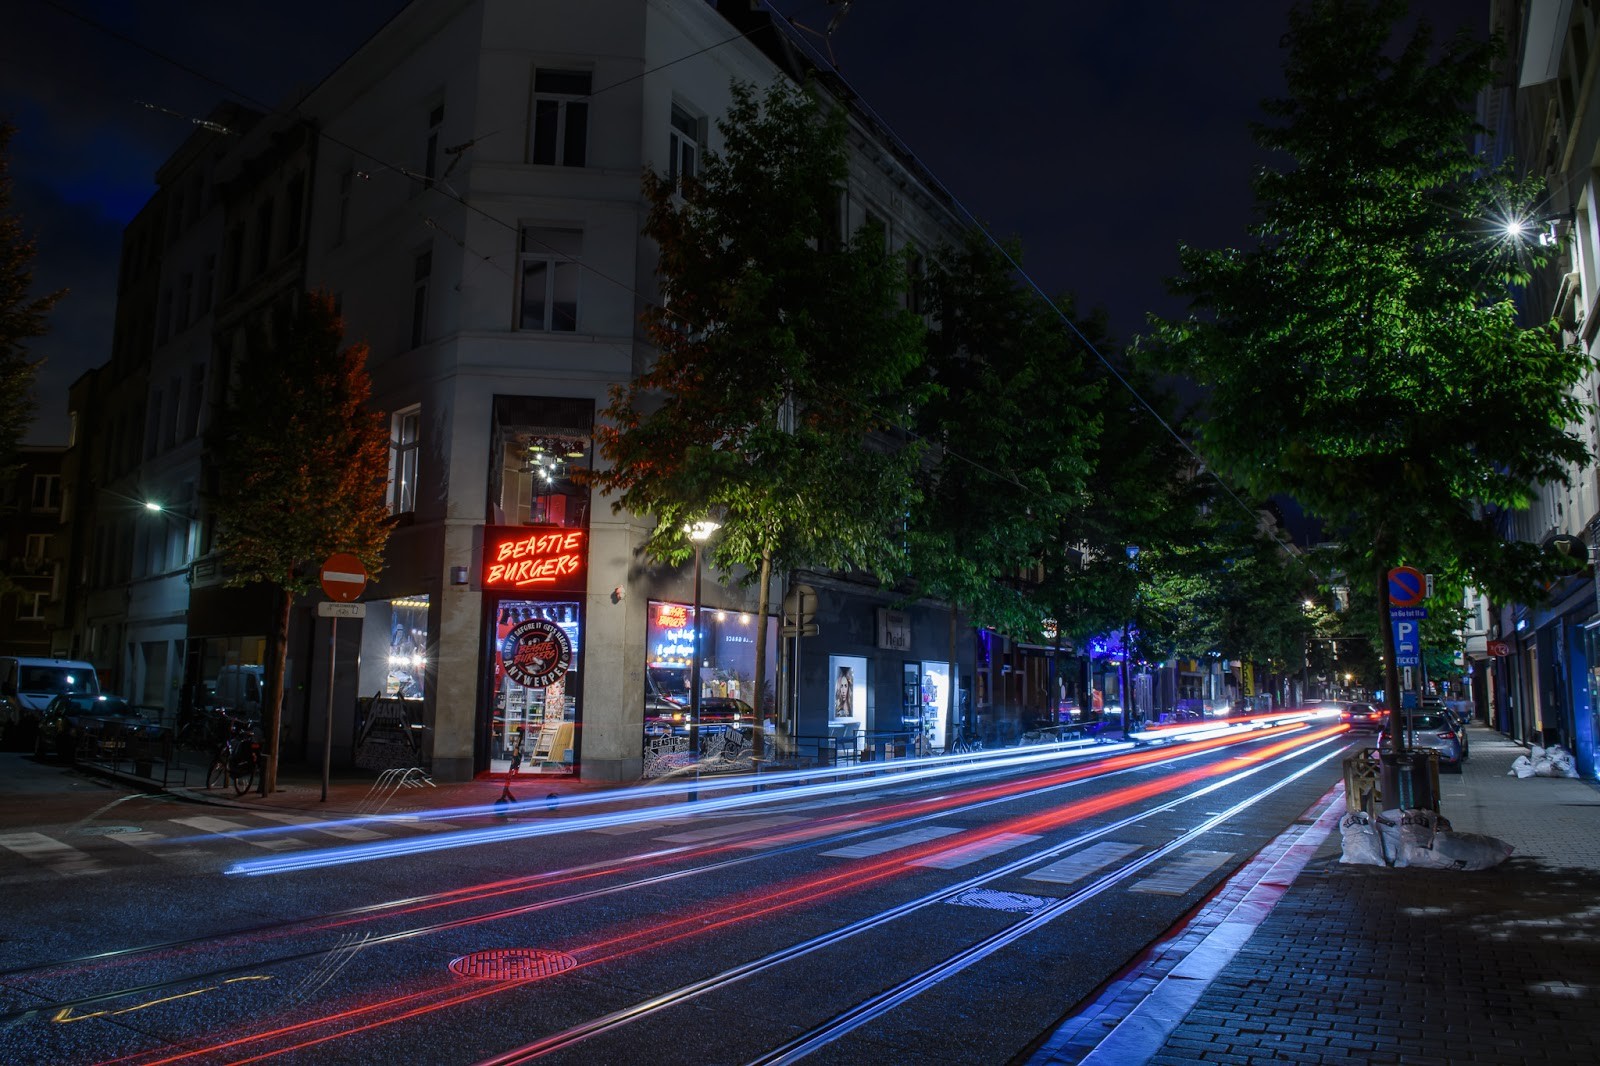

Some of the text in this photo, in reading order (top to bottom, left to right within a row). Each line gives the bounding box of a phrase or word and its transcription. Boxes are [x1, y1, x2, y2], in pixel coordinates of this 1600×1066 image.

[497, 531, 582, 561] BEASTIE
[487, 554, 580, 584] BURGERS
[503, 640, 513, 653] TRY
[514, 622, 536, 637] BEFORE
[543, 623, 558, 635] GETS
[555, 631, 569, 654] ILLEGAL
[1398, 622, 1412, 641] P
[513, 649, 556, 664] BURGERS
[518, 641, 555, 653] BEASTIE
[1396, 656, 1419, 665] TICKET
[503, 659, 569, 687] ANTWERPEN
[652, 737, 680, 748] BEASTIE
